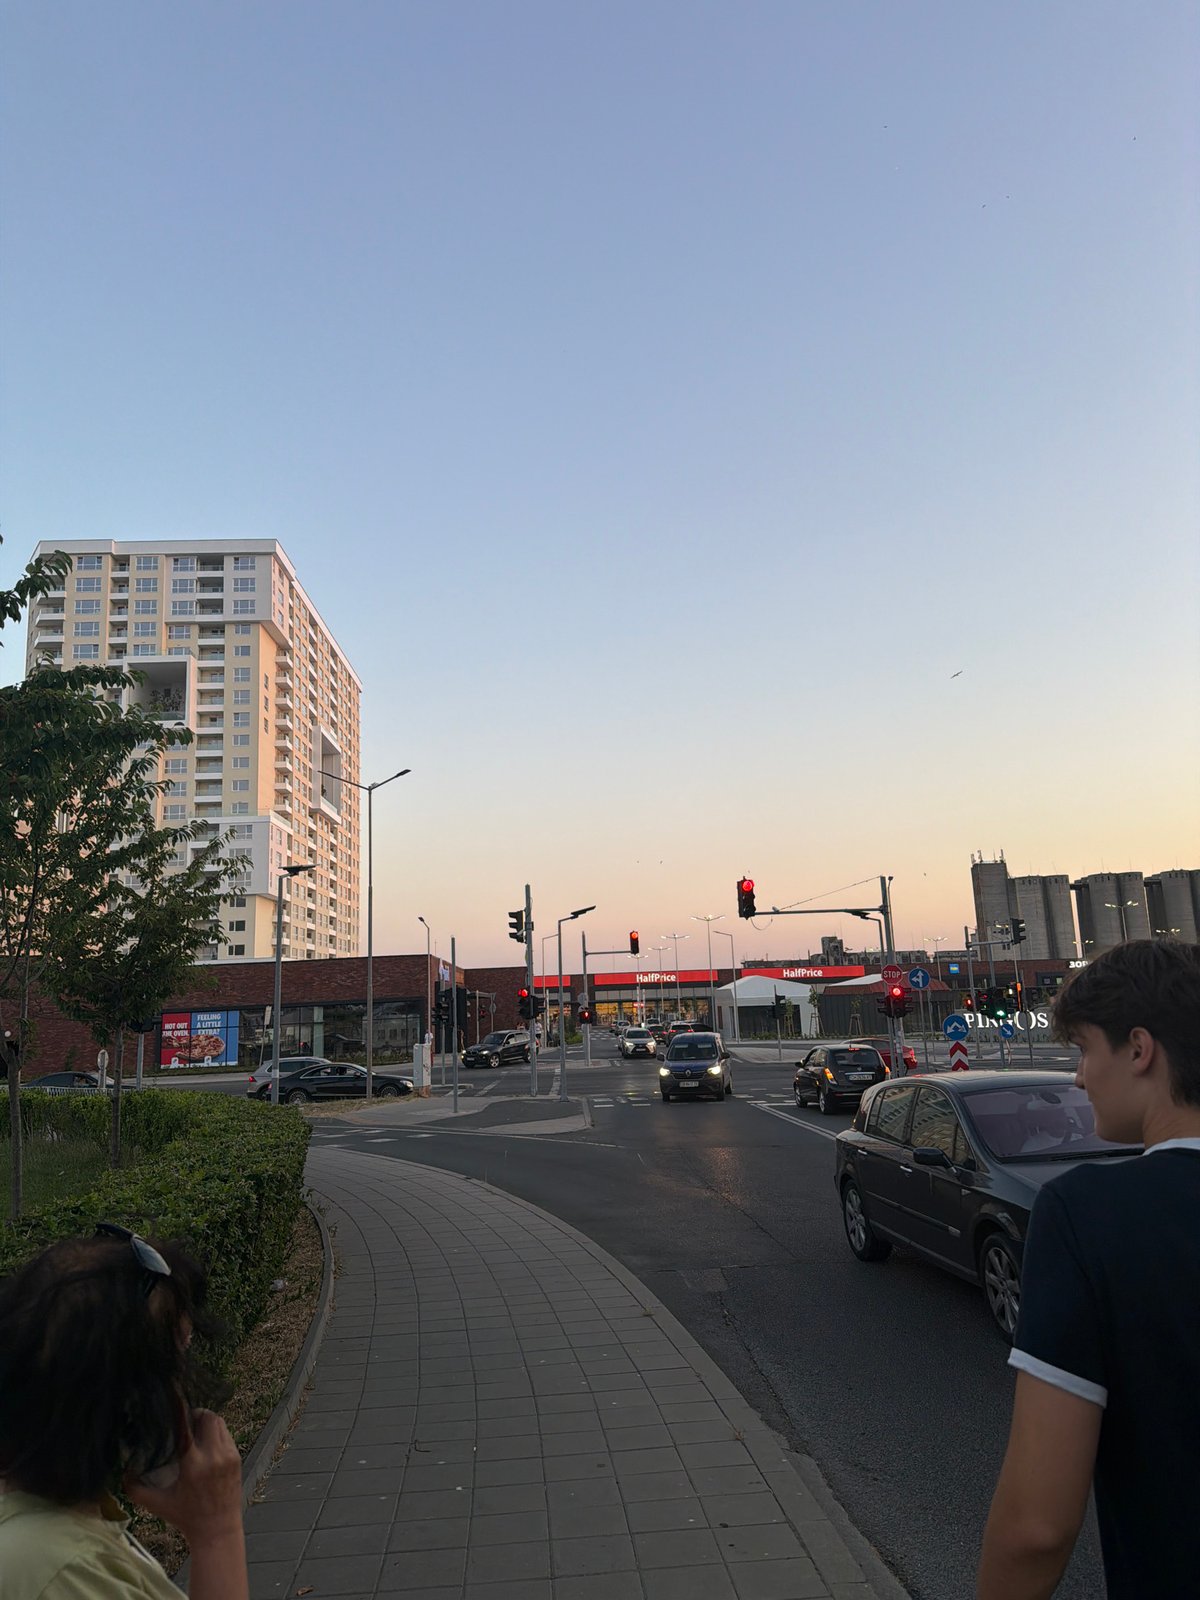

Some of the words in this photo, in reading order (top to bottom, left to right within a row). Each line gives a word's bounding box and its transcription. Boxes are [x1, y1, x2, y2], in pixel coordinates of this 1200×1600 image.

[636, 973, 676, 982] HalfPrice
[783, 968, 823, 978] HalfPrice
[883, 970, 901, 979] STOP
